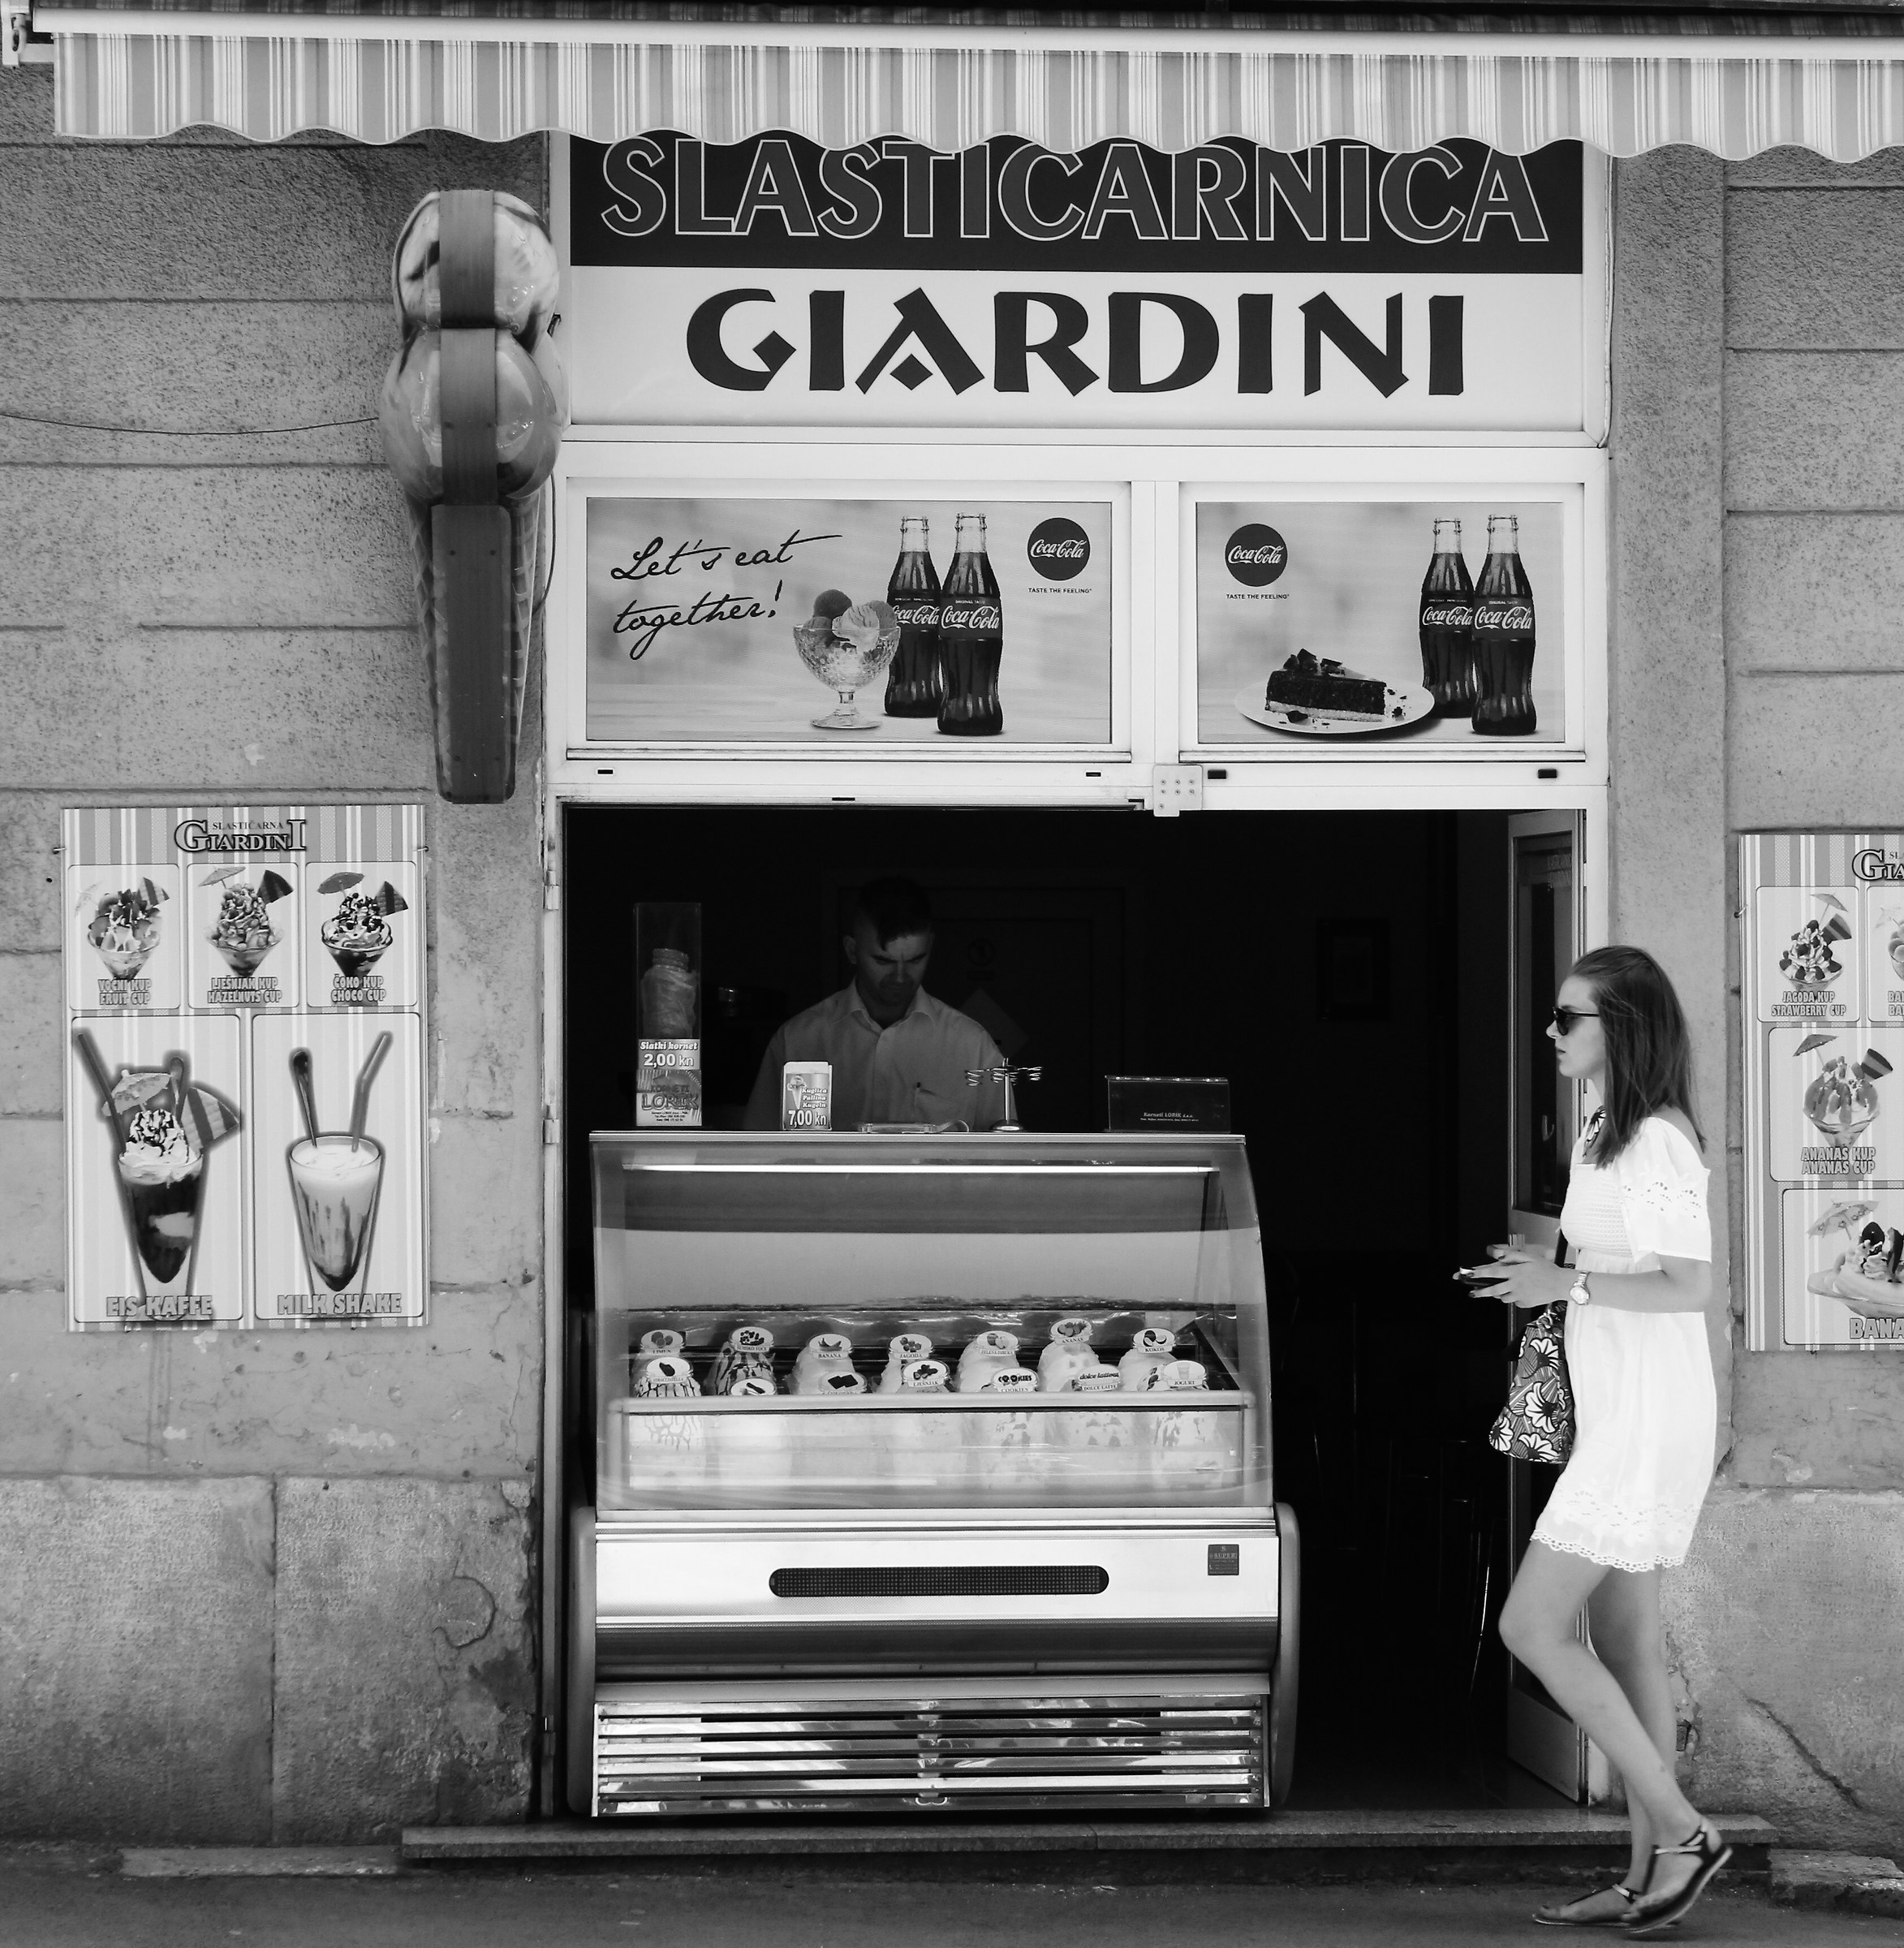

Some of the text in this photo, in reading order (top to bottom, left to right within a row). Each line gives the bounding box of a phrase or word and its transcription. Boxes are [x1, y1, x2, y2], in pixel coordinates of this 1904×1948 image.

[601, 135, 1550, 244] SLASTICARNICA
[686, 287, 1466, 399] GIARDINI
[610, 528, 843, 581] Let's eat
[1030, 538, 1088, 559] Coca-Cola
[1227, 545, 1285, 564] Coca-Cola
[613, 579, 784, 661] together!
[941, 605, 1000, 629] Coca-Cola
[1474, 606, 1532, 629] Coca-Cola
[174, 819, 308, 852] GIARDINI
[130, 978, 153, 992] KUP
[257, 976, 279, 990] KUP
[362, 976, 385, 989] KUP
[99, 992, 151, 1006] FRUIT CUP
[207, 989, 283, 1004] HAZELNUTS CUP
[330, 988, 387, 1002] CHOCO CUP
[1781, 990, 1836, 1003] JAGODA KUP
[1771, 1004, 1847, 1017] STRAWBERRY CUP
[640, 1041, 699, 1051] Slatki kornet
[644, 1053, 695, 1069] 2,00 kn
[788, 1110, 827, 1128] 7,00 kn
[1800, 1146, 1876, 1161] ANANAS KUP
[1801, 1161, 1876, 1175] ANANAS CUP
[106, 1295, 213, 1317] EIS KAFFE
[277, 1292, 403, 1316] MILK SHAKE
[1849, 1317, 1904, 1341] BANA
